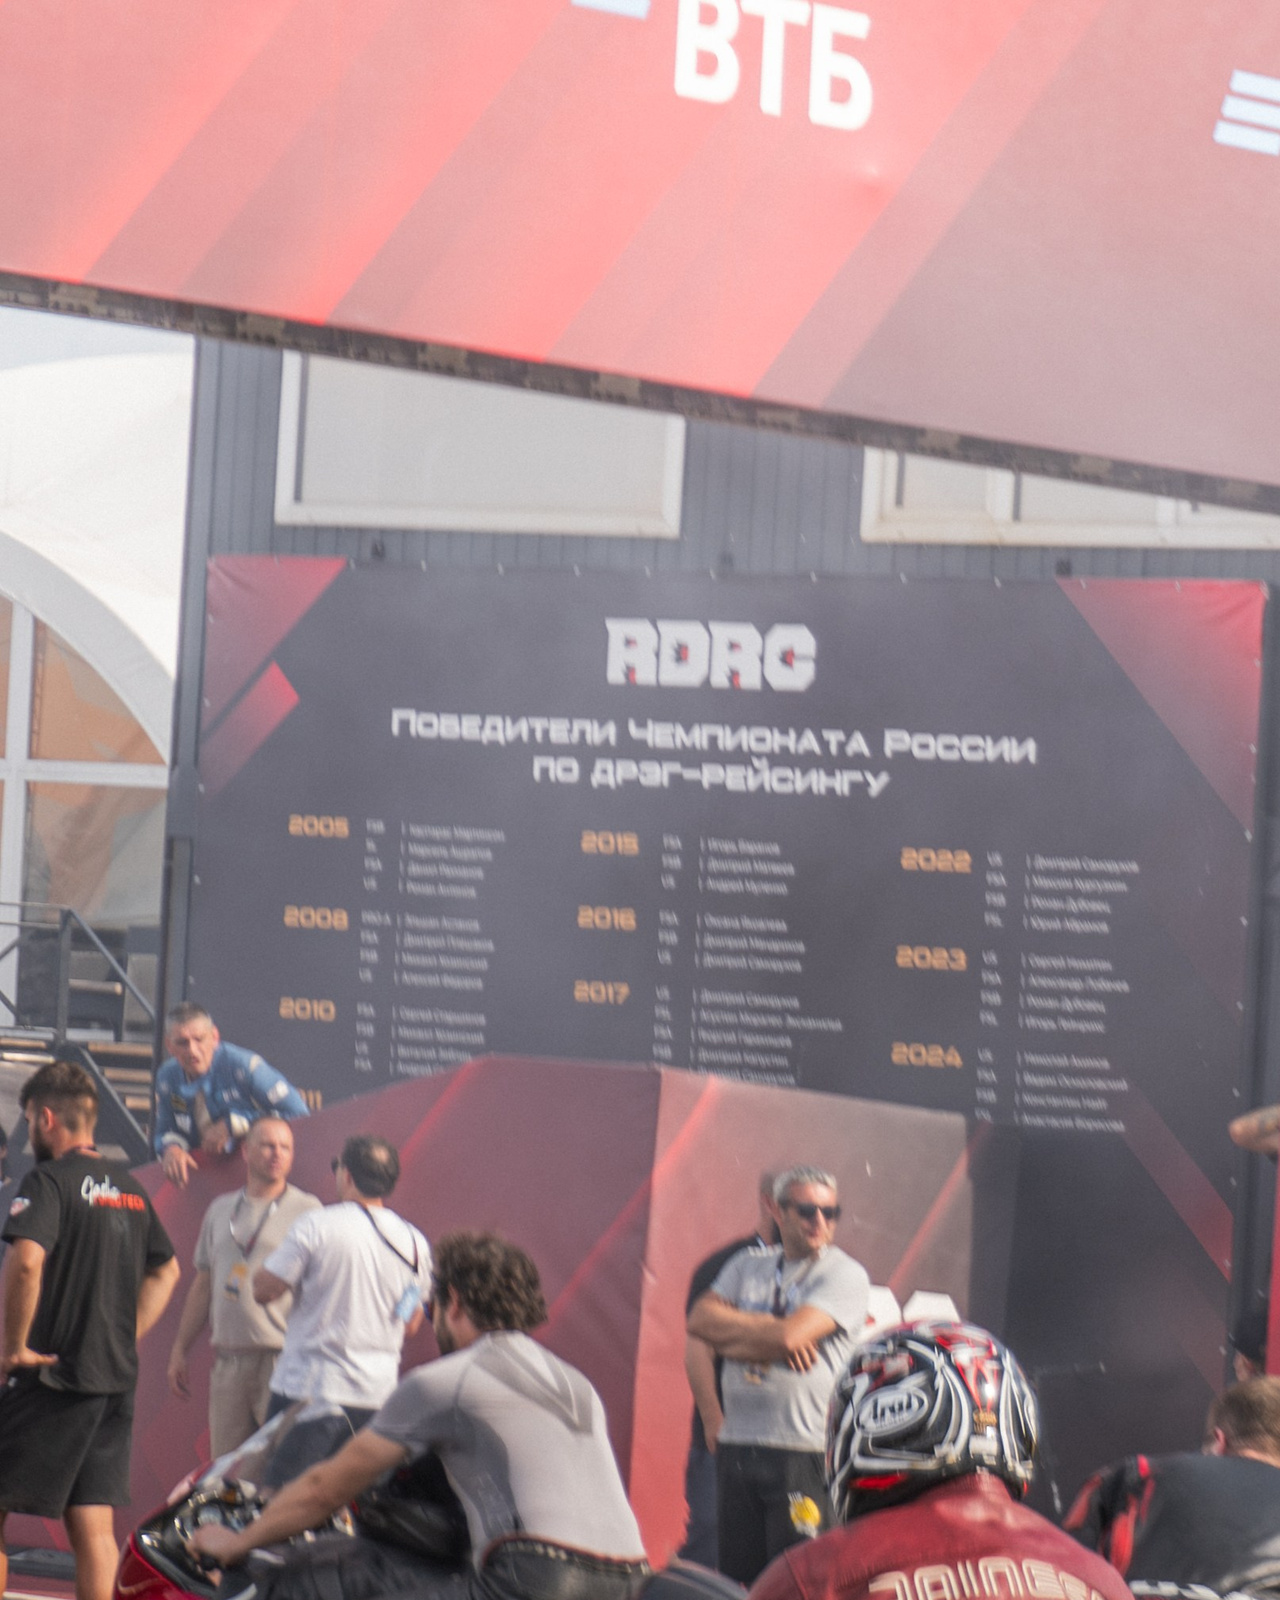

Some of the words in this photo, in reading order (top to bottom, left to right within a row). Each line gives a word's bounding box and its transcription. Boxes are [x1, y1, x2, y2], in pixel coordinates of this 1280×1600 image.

[673, 0, 874, 132] ВТБ
[605, 617, 816, 692] RDRC
[289, 813, 349, 839] 2005
[580, 829, 640, 857] 2015
[900, 846, 972, 874] 2022
[284, 904, 349, 931] 2008
[577, 904, 637, 932] 2016
[896, 944, 967, 972] 2023
[573, 979, 630, 1006] 2017
[279, 996, 336, 1022] 2010
[891, 1041, 963, 1069] 2024
